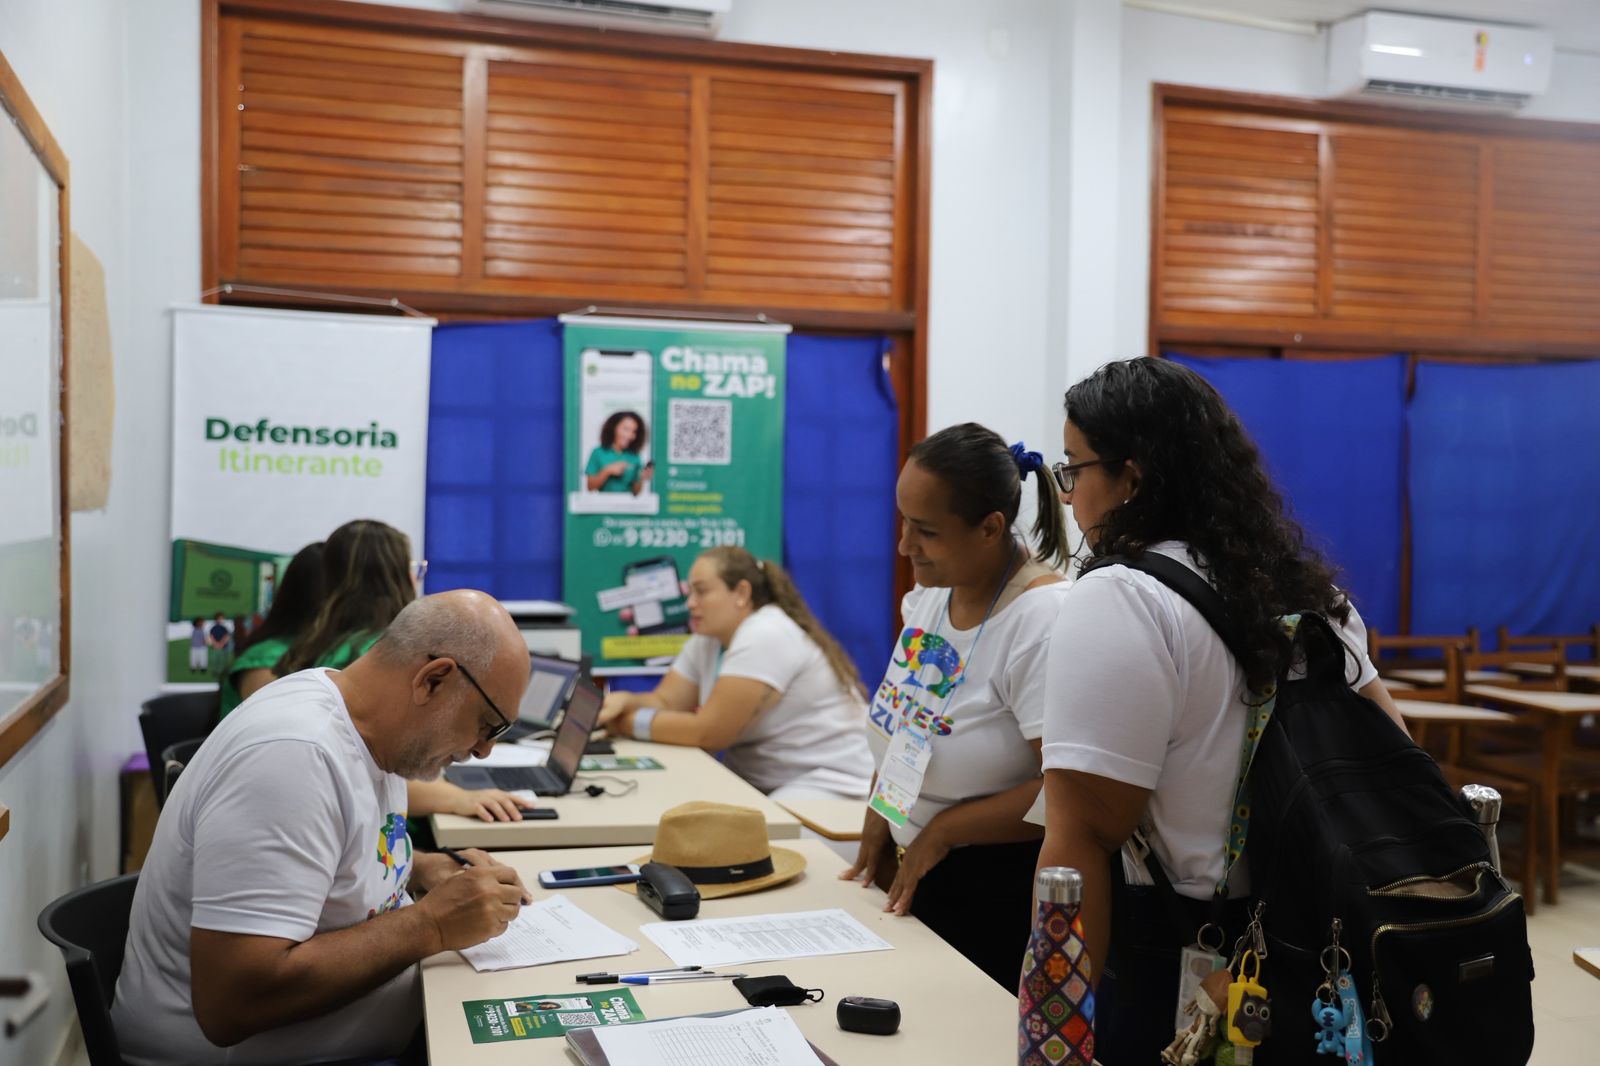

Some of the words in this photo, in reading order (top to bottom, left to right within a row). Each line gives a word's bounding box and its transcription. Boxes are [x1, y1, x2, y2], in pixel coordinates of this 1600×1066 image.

[660, 346, 768, 374] Chama
[670, 374, 701, 391] no
[703, 374, 776, 398] ZAP!
[204, 417, 398, 448] Defensoria
[217, 447, 384, 477] Itinerante
[609, 996, 631, 1020] Chama
